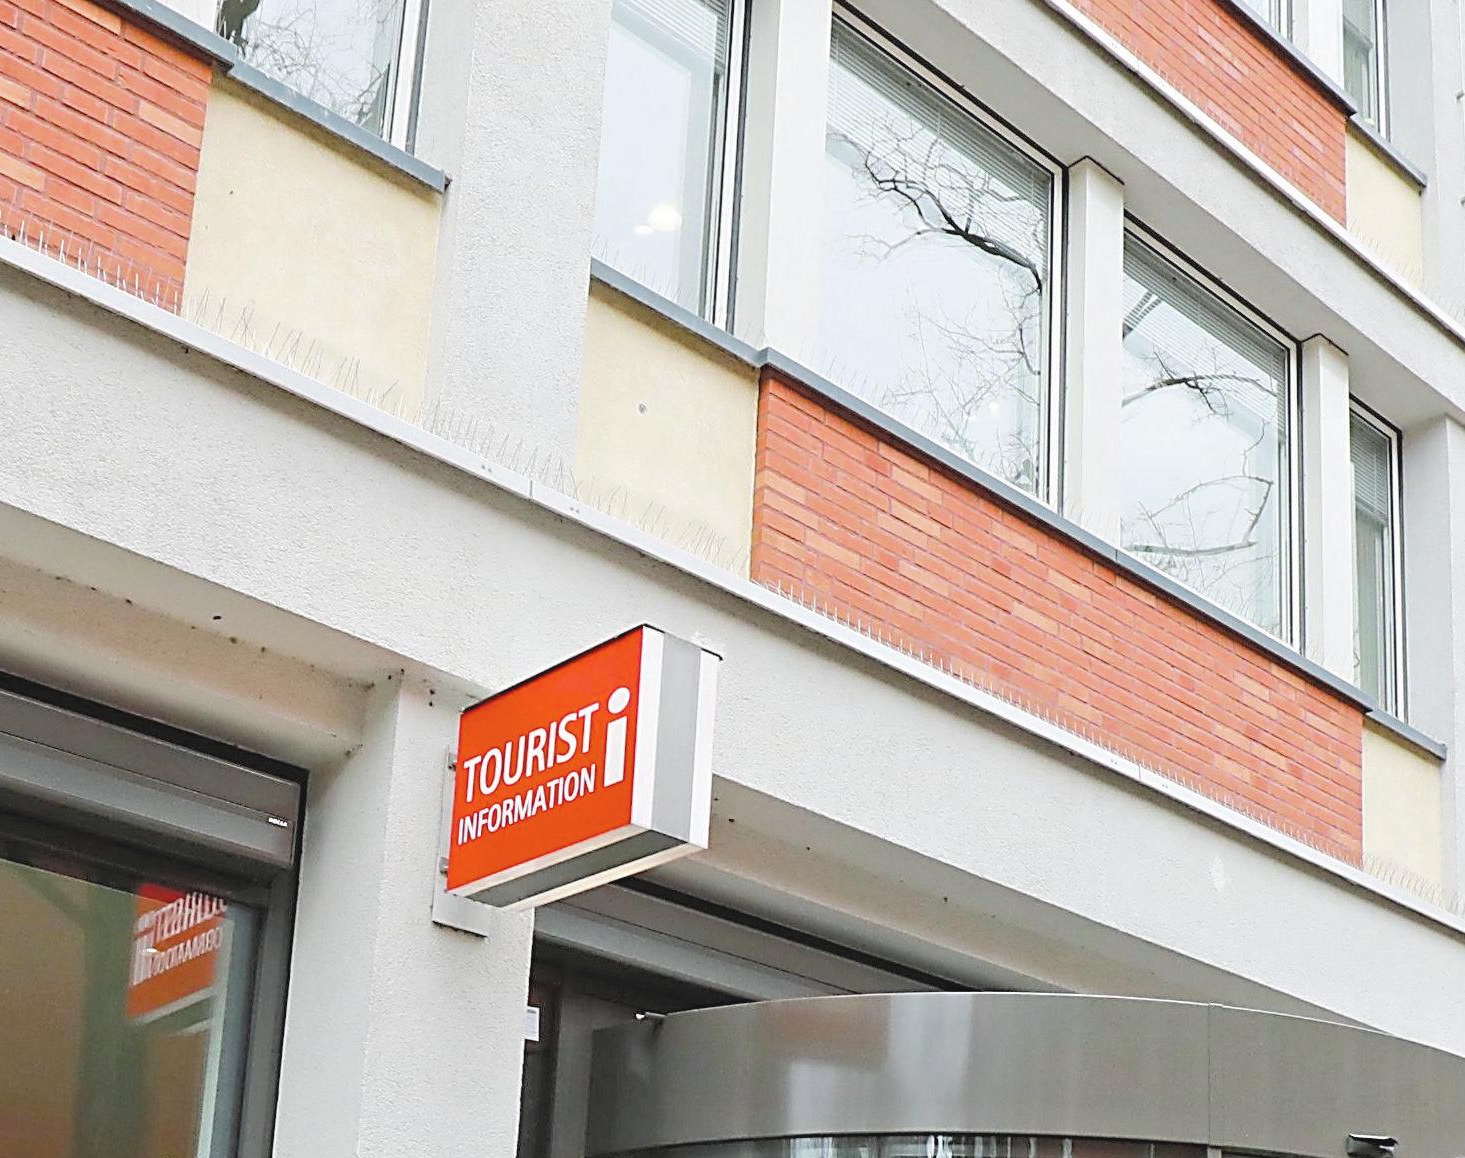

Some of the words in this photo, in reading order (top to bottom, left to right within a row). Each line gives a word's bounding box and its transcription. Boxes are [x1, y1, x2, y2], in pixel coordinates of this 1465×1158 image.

[463, 701, 600, 803] TOURIST
[603, 686, 630, 787] i
[458, 764, 596, 845] INFORMATION
